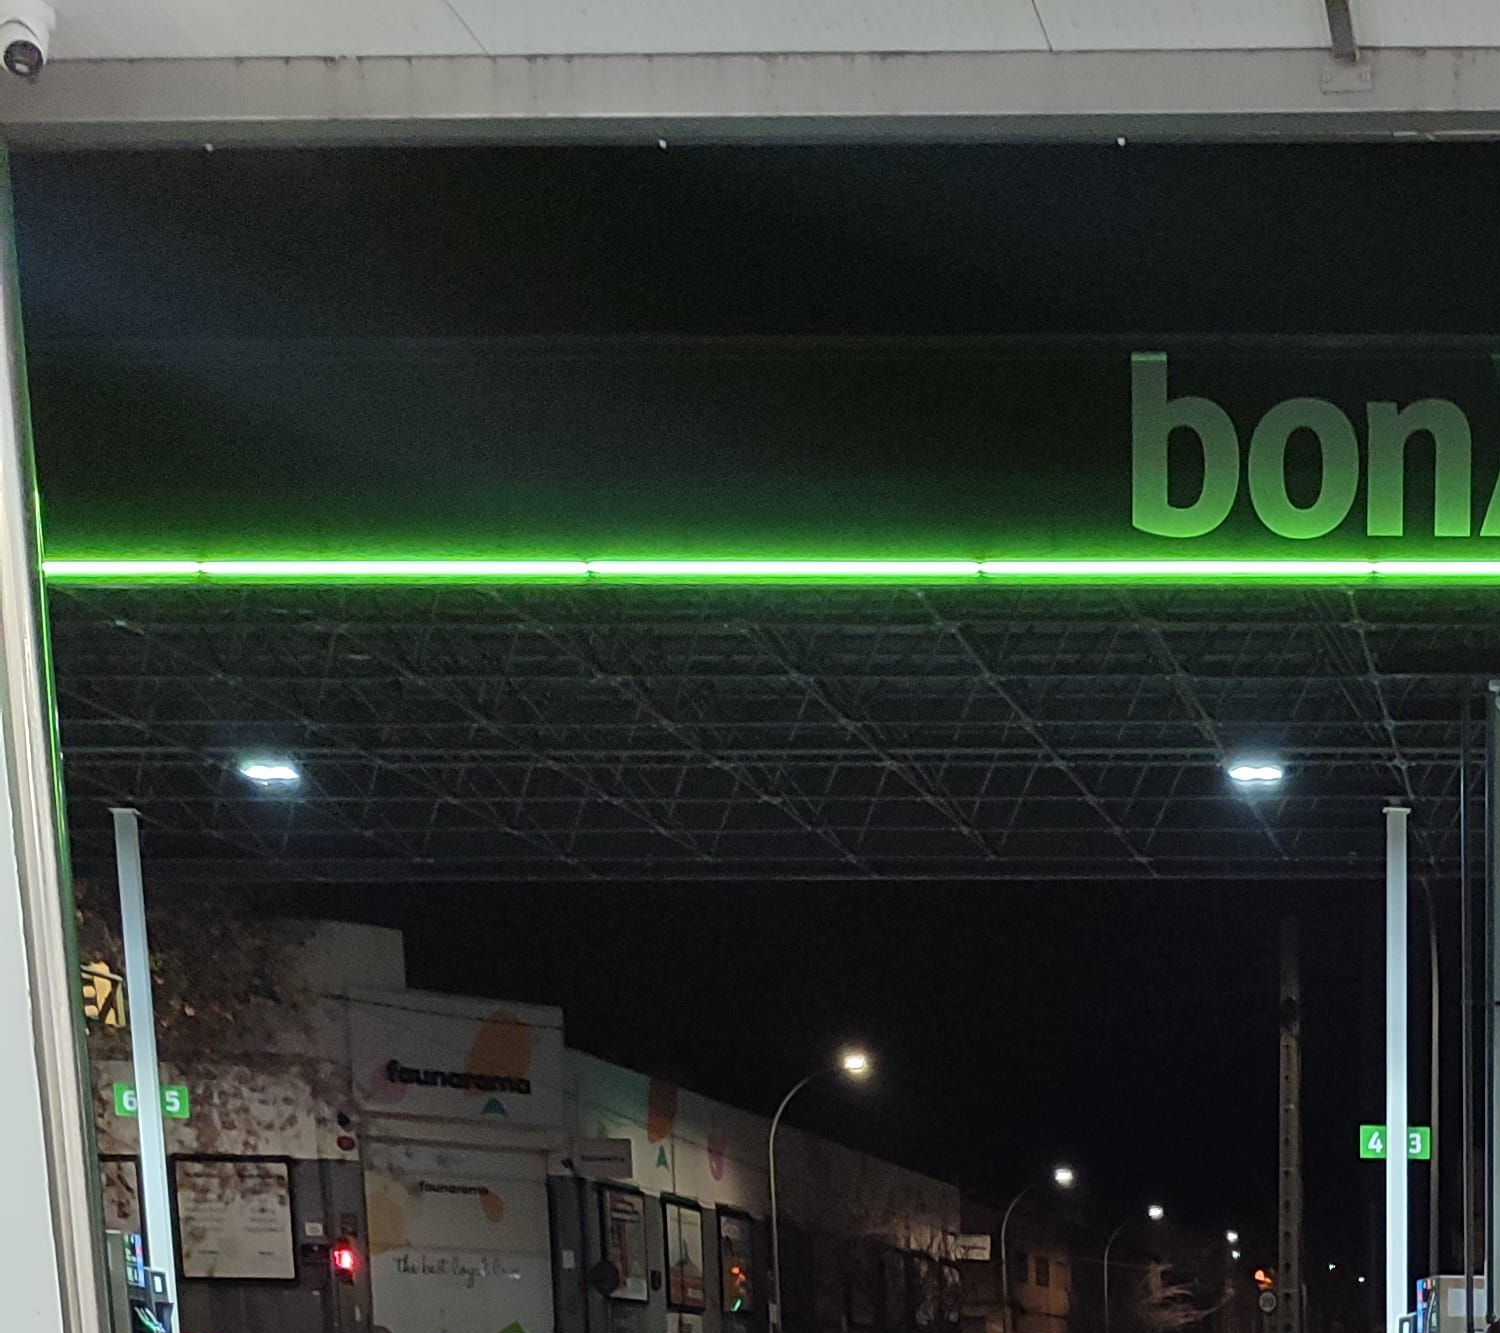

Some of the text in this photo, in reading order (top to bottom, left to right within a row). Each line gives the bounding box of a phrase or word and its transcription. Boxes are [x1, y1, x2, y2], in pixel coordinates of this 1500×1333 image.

[165, 1090, 181, 1112] 5
[1368, 1131, 1422, 1153] 4 3
